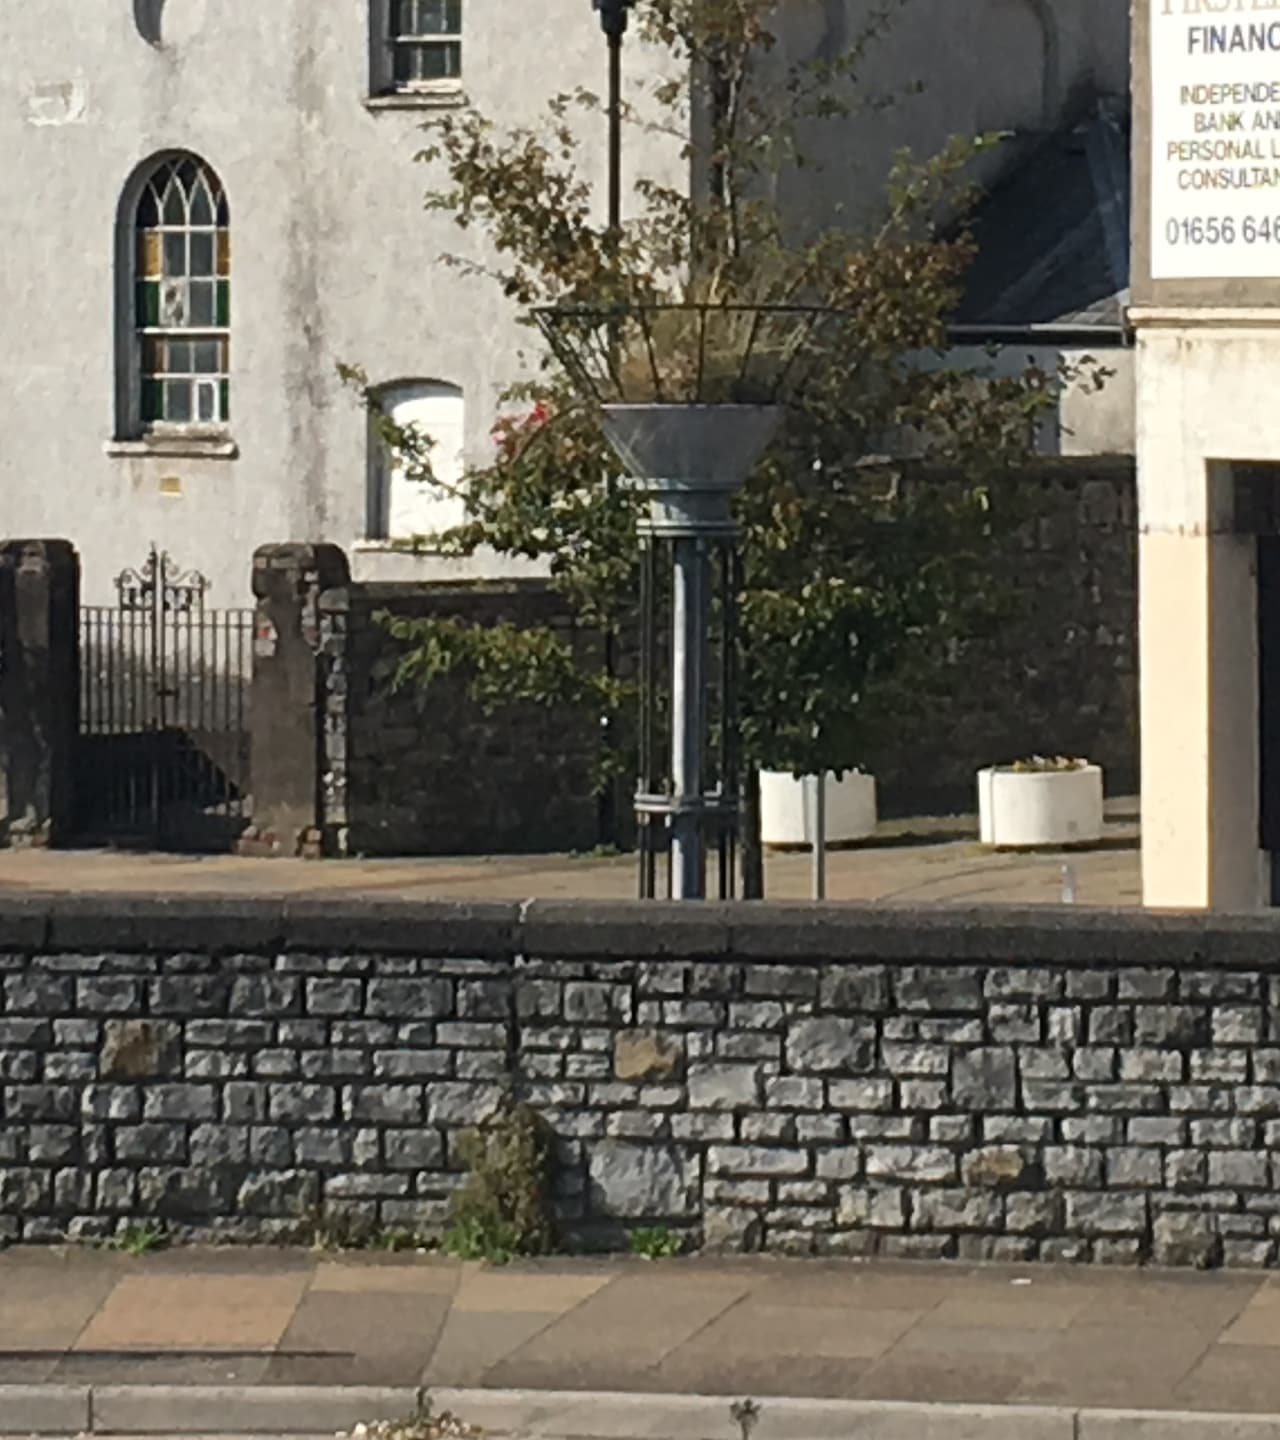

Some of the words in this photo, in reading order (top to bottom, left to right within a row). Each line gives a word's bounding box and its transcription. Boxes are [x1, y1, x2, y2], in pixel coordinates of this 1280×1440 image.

[1194, 112, 1244, 133] BANK
[1167, 139, 1266, 161] PERSONAL
[1166, 216, 1236, 245] 01656
